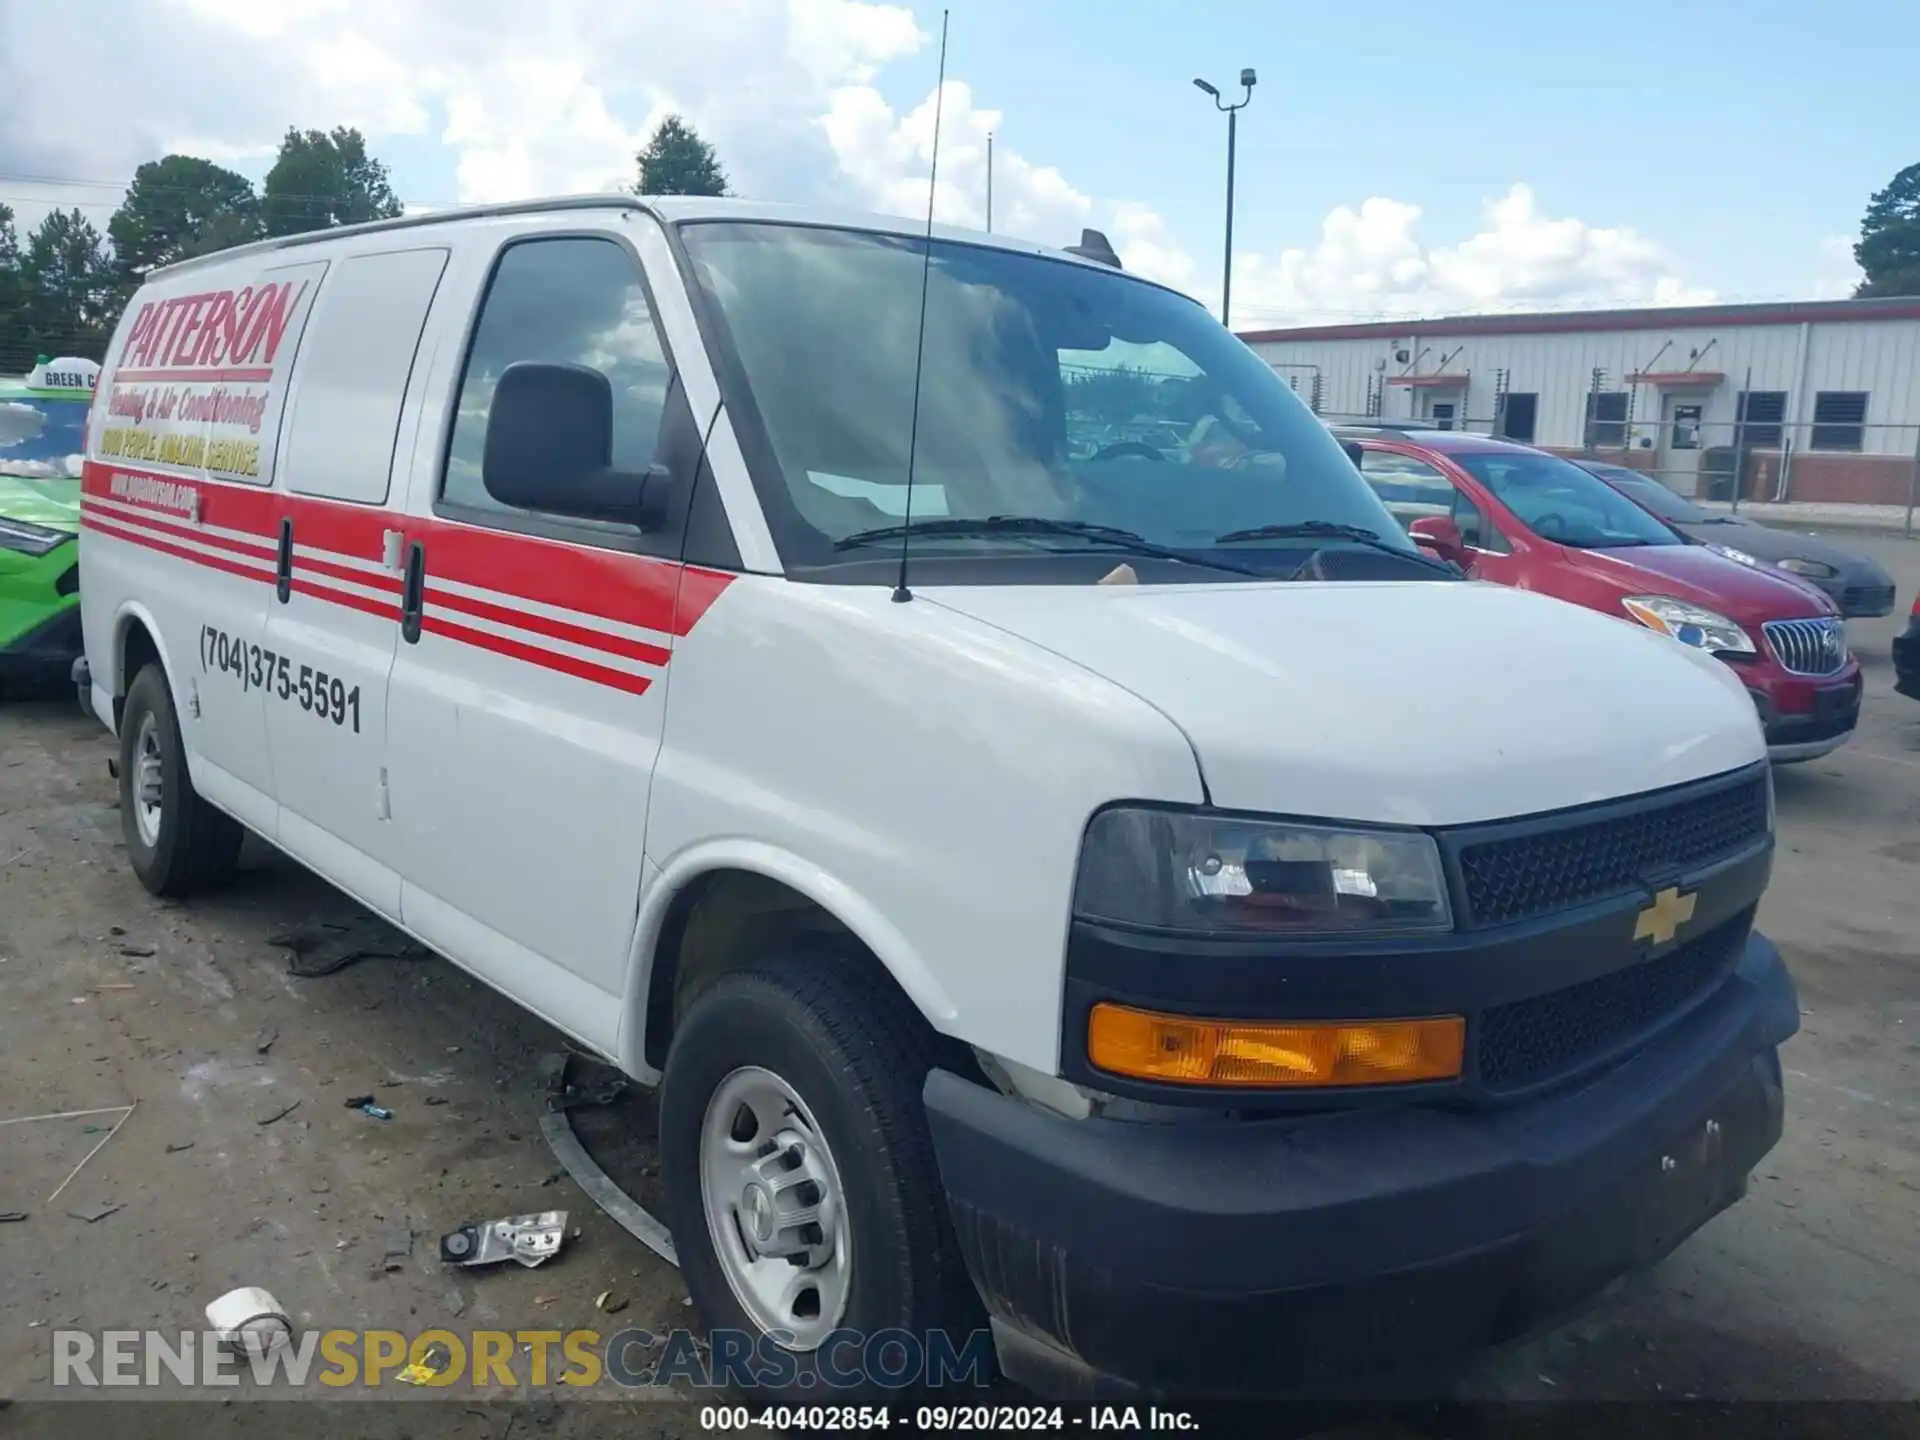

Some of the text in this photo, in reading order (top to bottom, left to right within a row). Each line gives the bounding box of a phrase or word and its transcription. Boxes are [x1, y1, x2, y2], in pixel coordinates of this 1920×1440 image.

[117, 280, 309, 367] PATTERSON
[45, 371, 83, 388] GREEN
[200, 623, 361, 735] (704)375-5591
